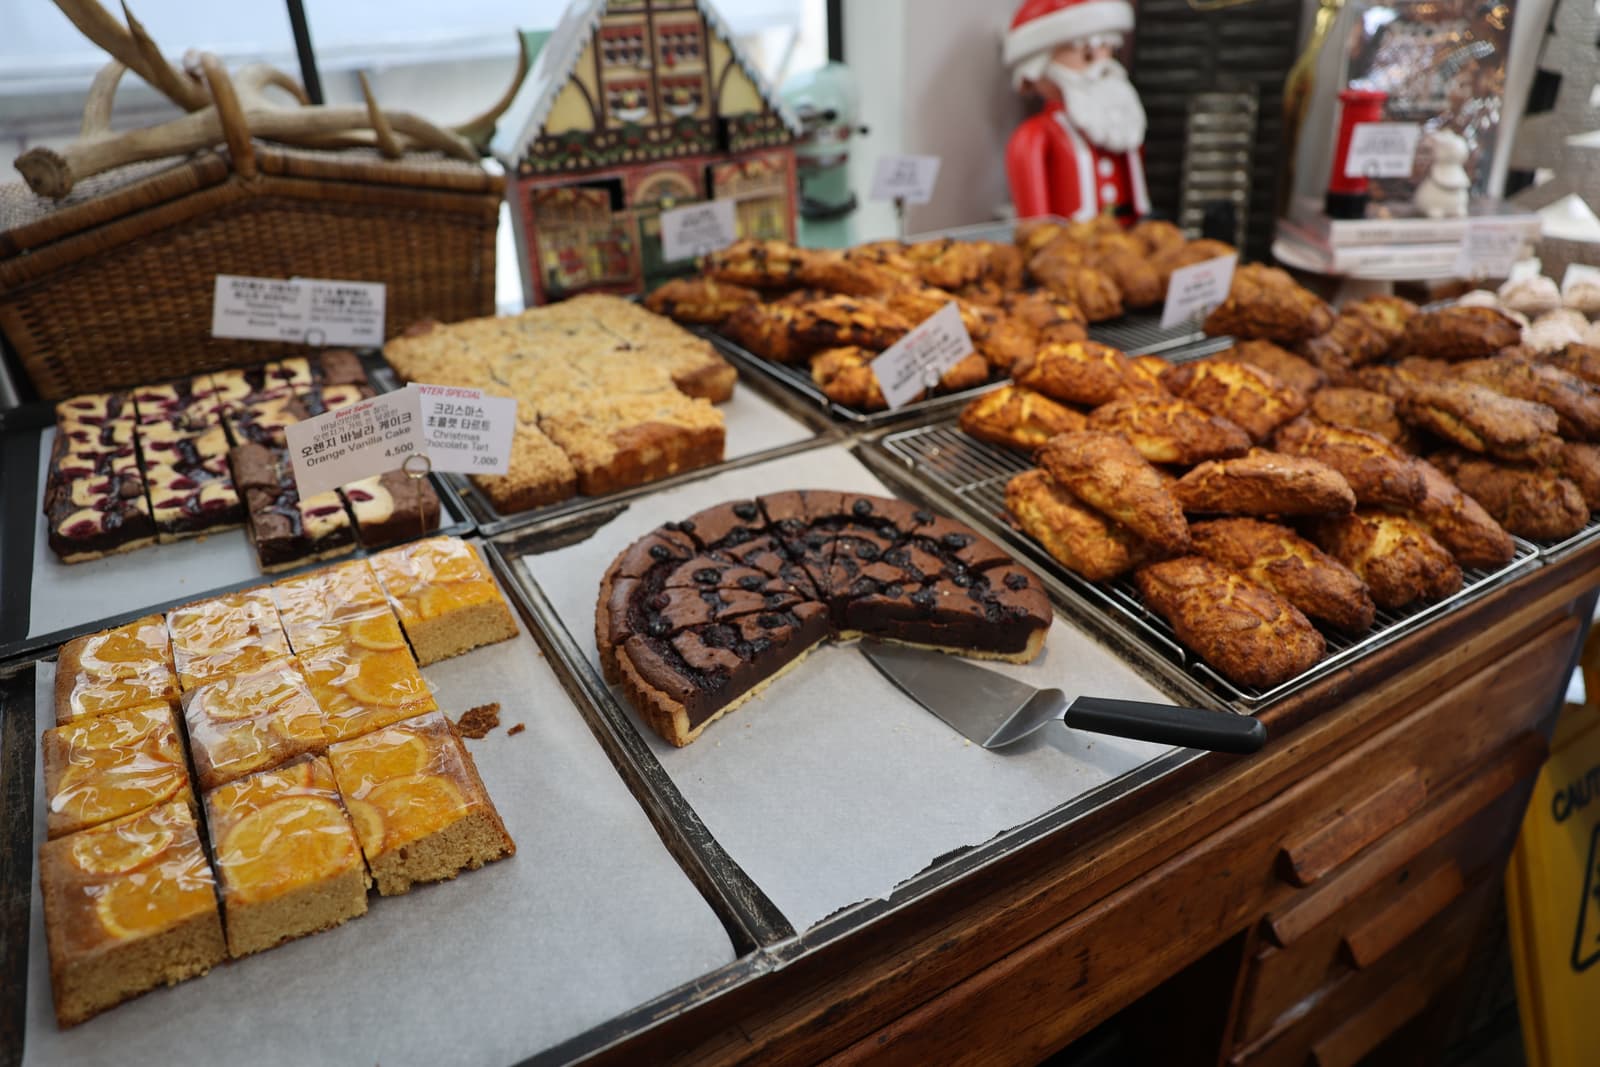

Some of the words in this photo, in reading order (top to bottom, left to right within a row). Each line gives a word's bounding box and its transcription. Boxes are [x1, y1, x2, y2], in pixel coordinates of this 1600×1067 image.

[419, 386, 443, 395] NTER
[446, 389, 480, 399] SPECIAL
[433, 402, 485, 418] 크리스마스
[461, 418, 491, 432] 타르트
[301, 437, 337, 458] 오렌지
[340, 424, 374, 443] 바닐라
[379, 411, 412, 431] 케이크
[433, 429, 480, 442] Christmas
[306, 448, 346, 467] Orange
[347, 436, 383, 452] Vanilla
[385, 426, 411, 440] Cake
[472, 442, 489, 452] Tart
